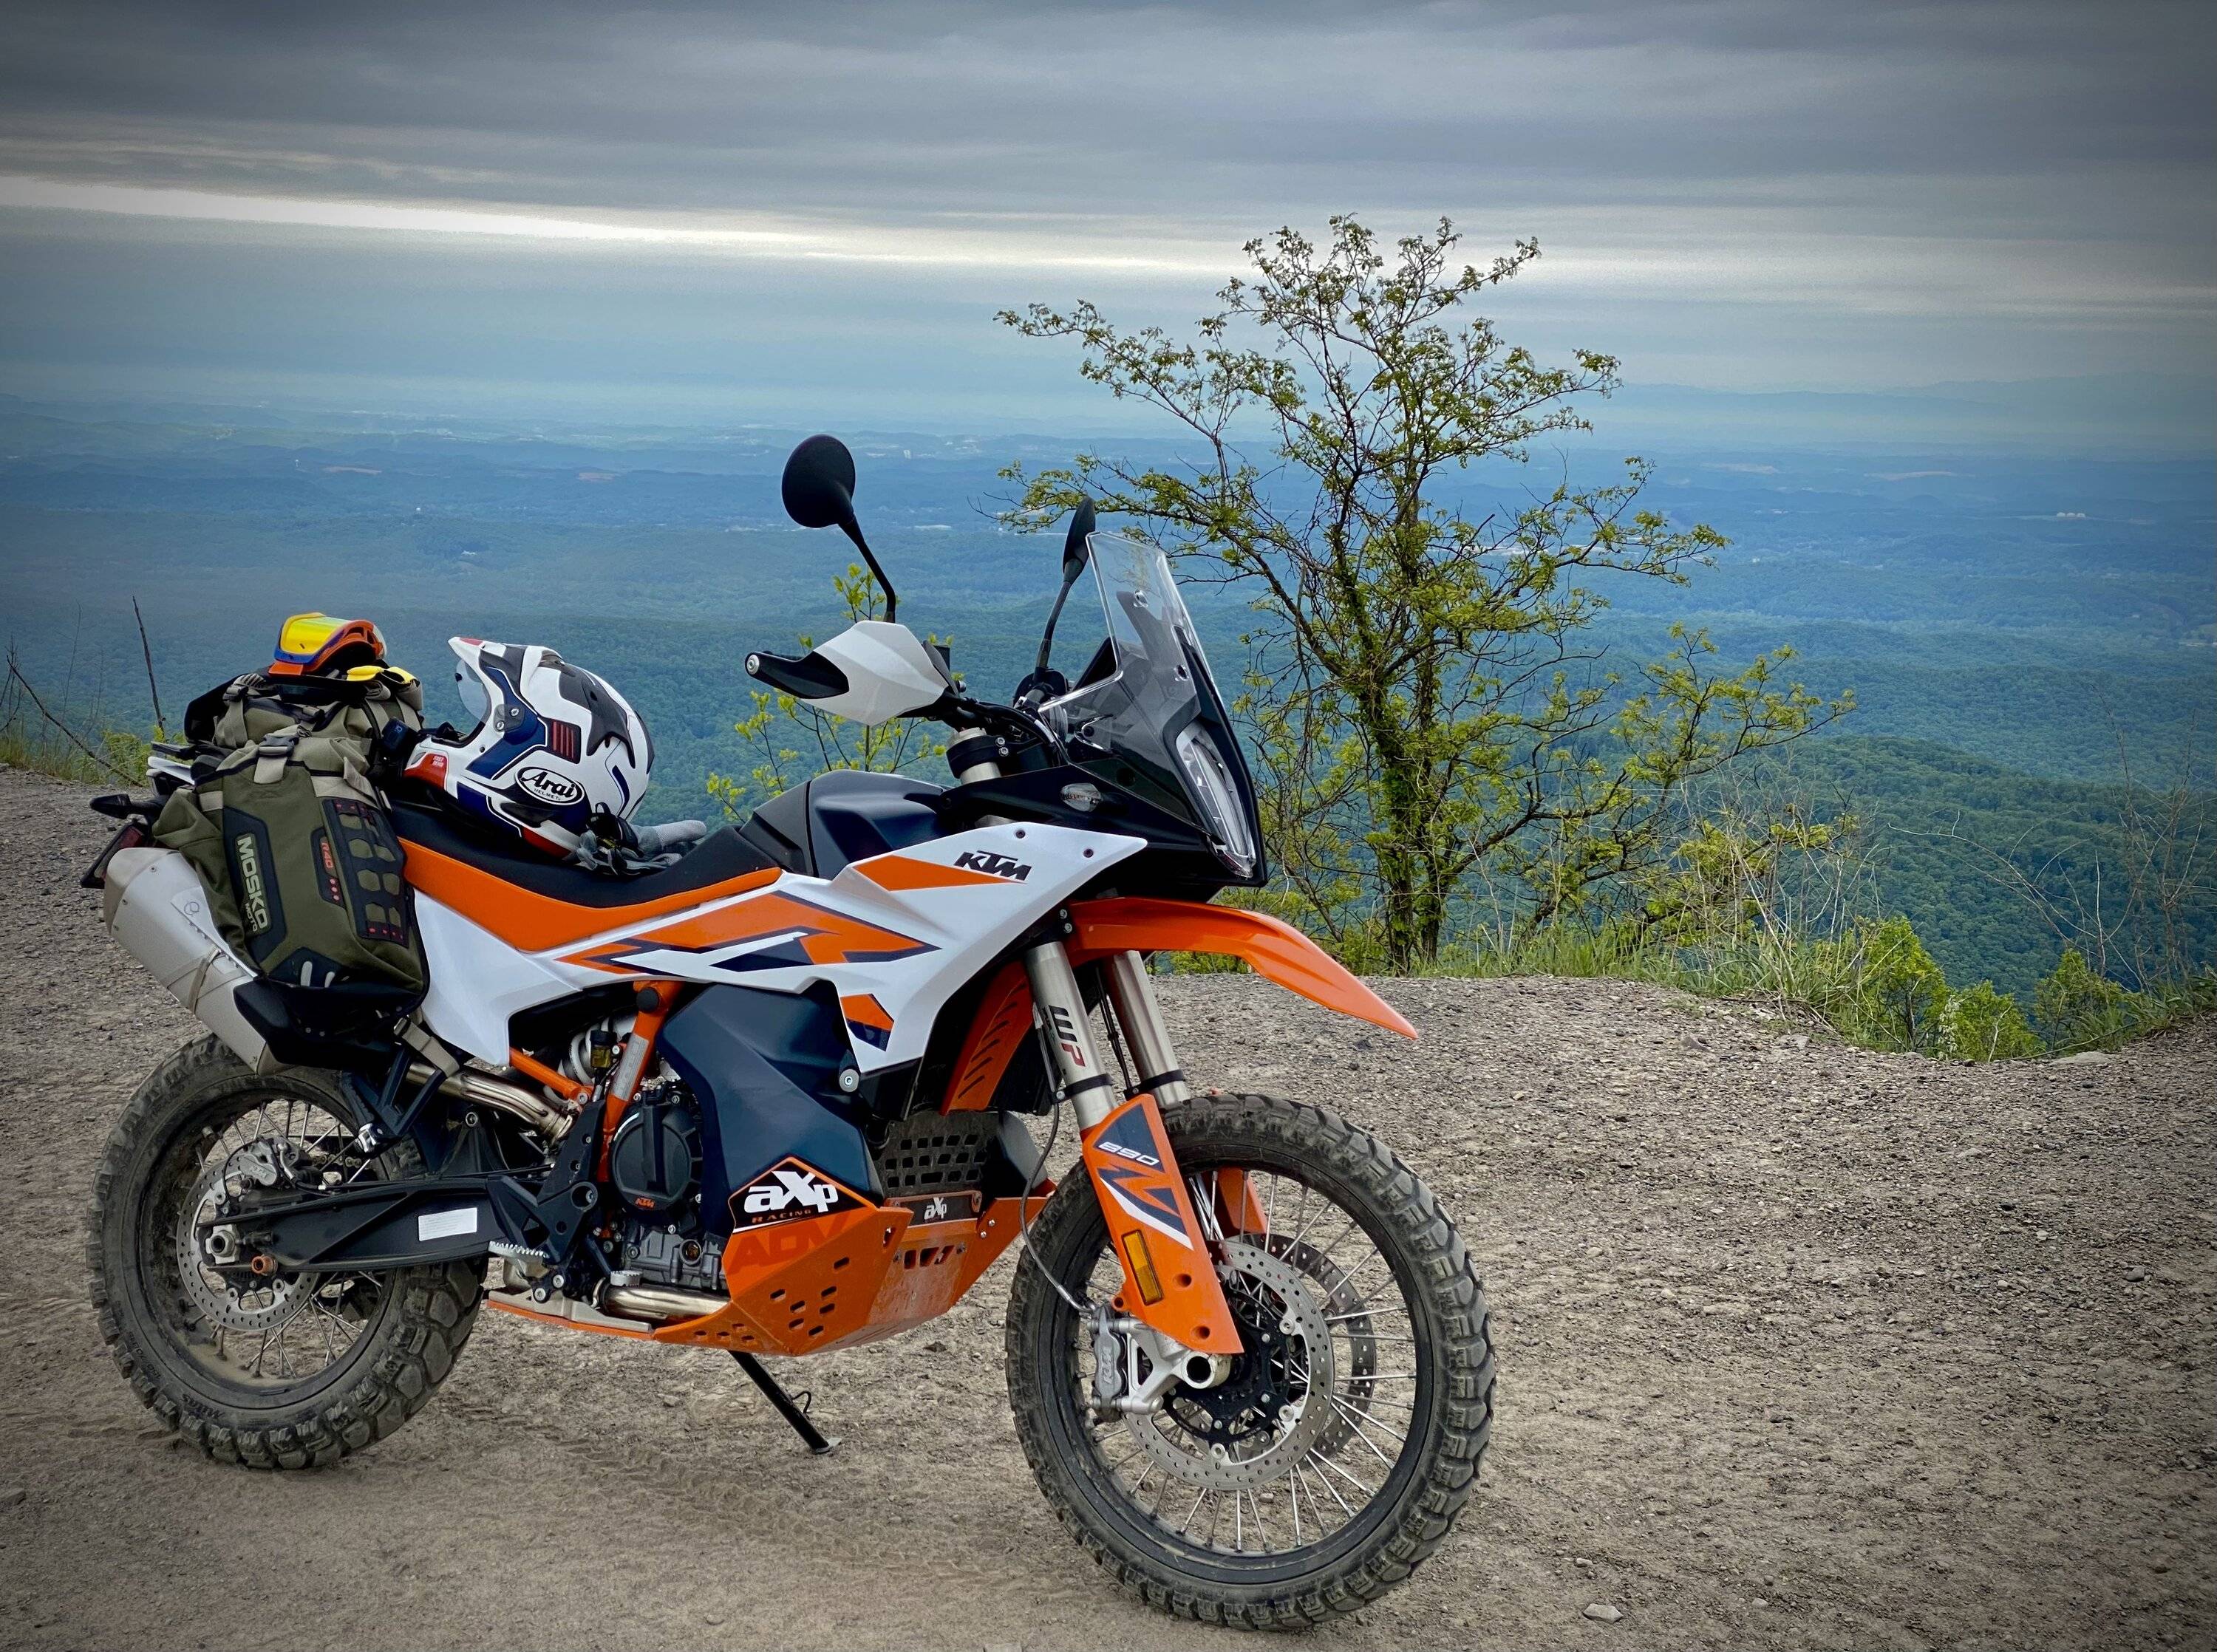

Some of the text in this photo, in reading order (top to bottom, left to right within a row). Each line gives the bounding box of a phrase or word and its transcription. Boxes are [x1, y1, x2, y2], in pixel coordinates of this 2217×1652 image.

[521, 771, 576, 798] Arai
[534, 788, 559, 799] HELMET
[953, 850, 1032, 881] KTM
[237, 836, 268, 929] MOSKO
[245, 902, 257, 932] MOTO
[1049, 1005, 1086, 1067] WP
[1098, 1141, 1159, 1166] 890
[752, 1209, 811, 1223] RACING
